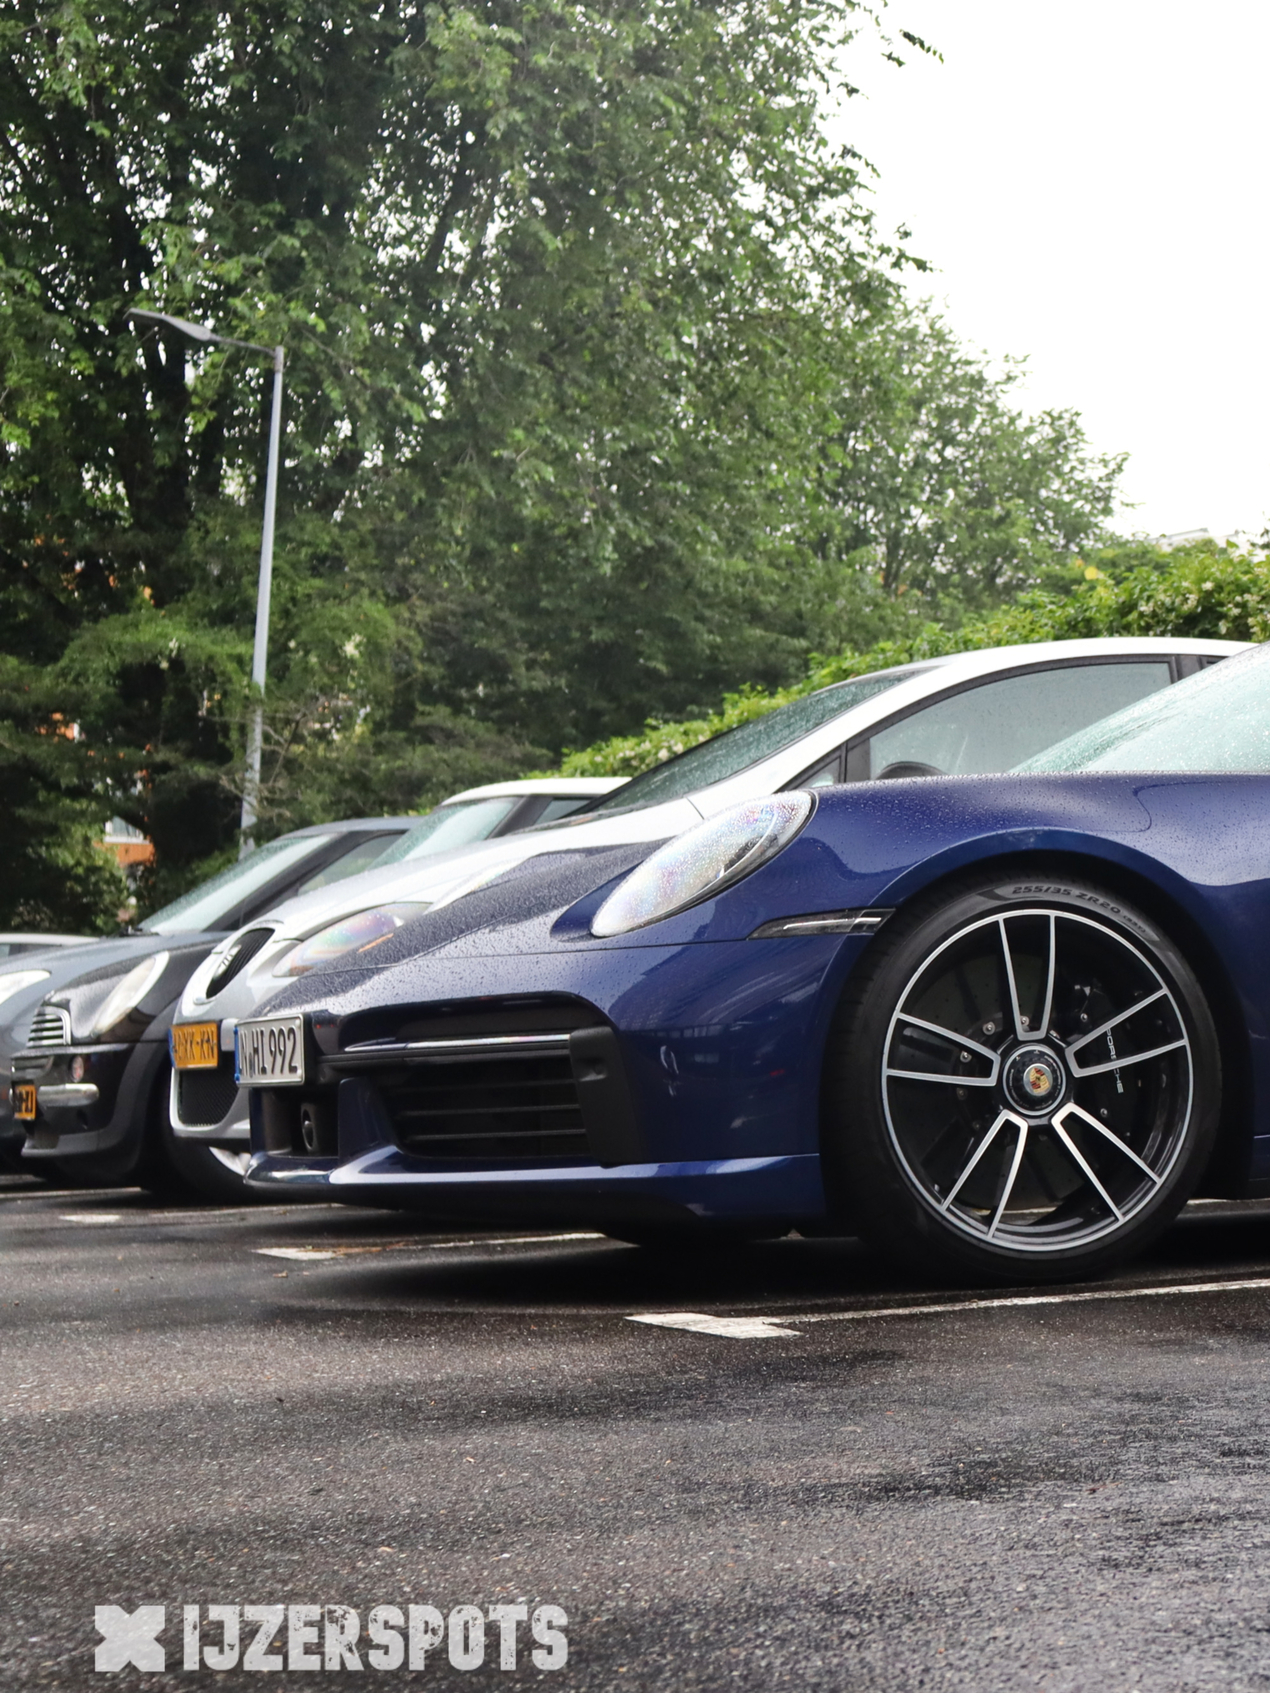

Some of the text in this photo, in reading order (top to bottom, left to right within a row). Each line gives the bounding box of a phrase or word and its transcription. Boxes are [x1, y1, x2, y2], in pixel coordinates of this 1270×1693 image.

[1012, 884, 1074, 897] 255/35
[1075, 891, 1121, 915] ZR20
[268, 1026, 298, 1075] 992
